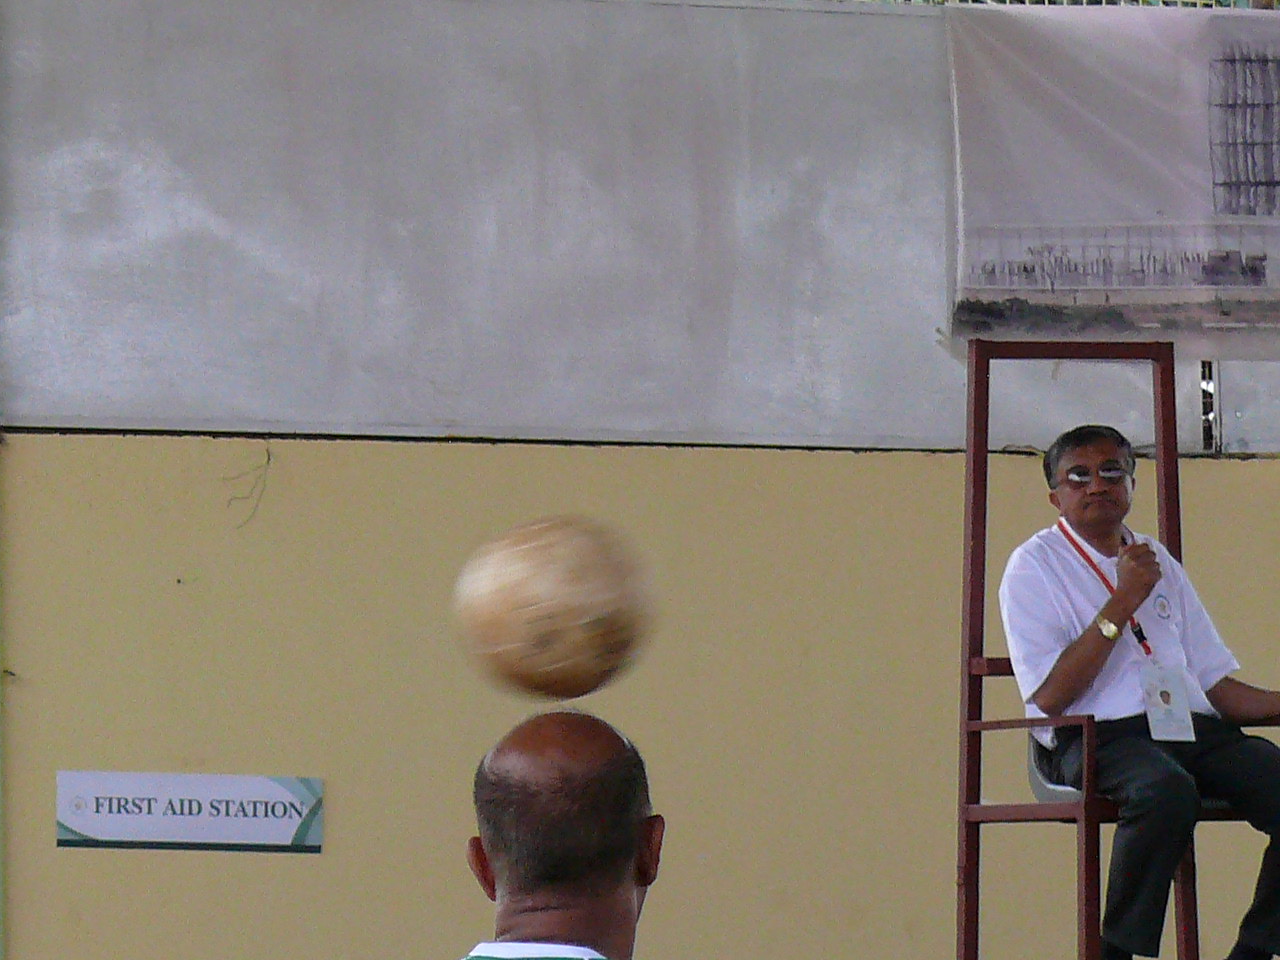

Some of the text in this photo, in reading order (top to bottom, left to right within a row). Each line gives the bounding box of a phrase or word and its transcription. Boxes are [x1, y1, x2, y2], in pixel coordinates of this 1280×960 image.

[94, 796, 305, 819] FIRST AID STATION
